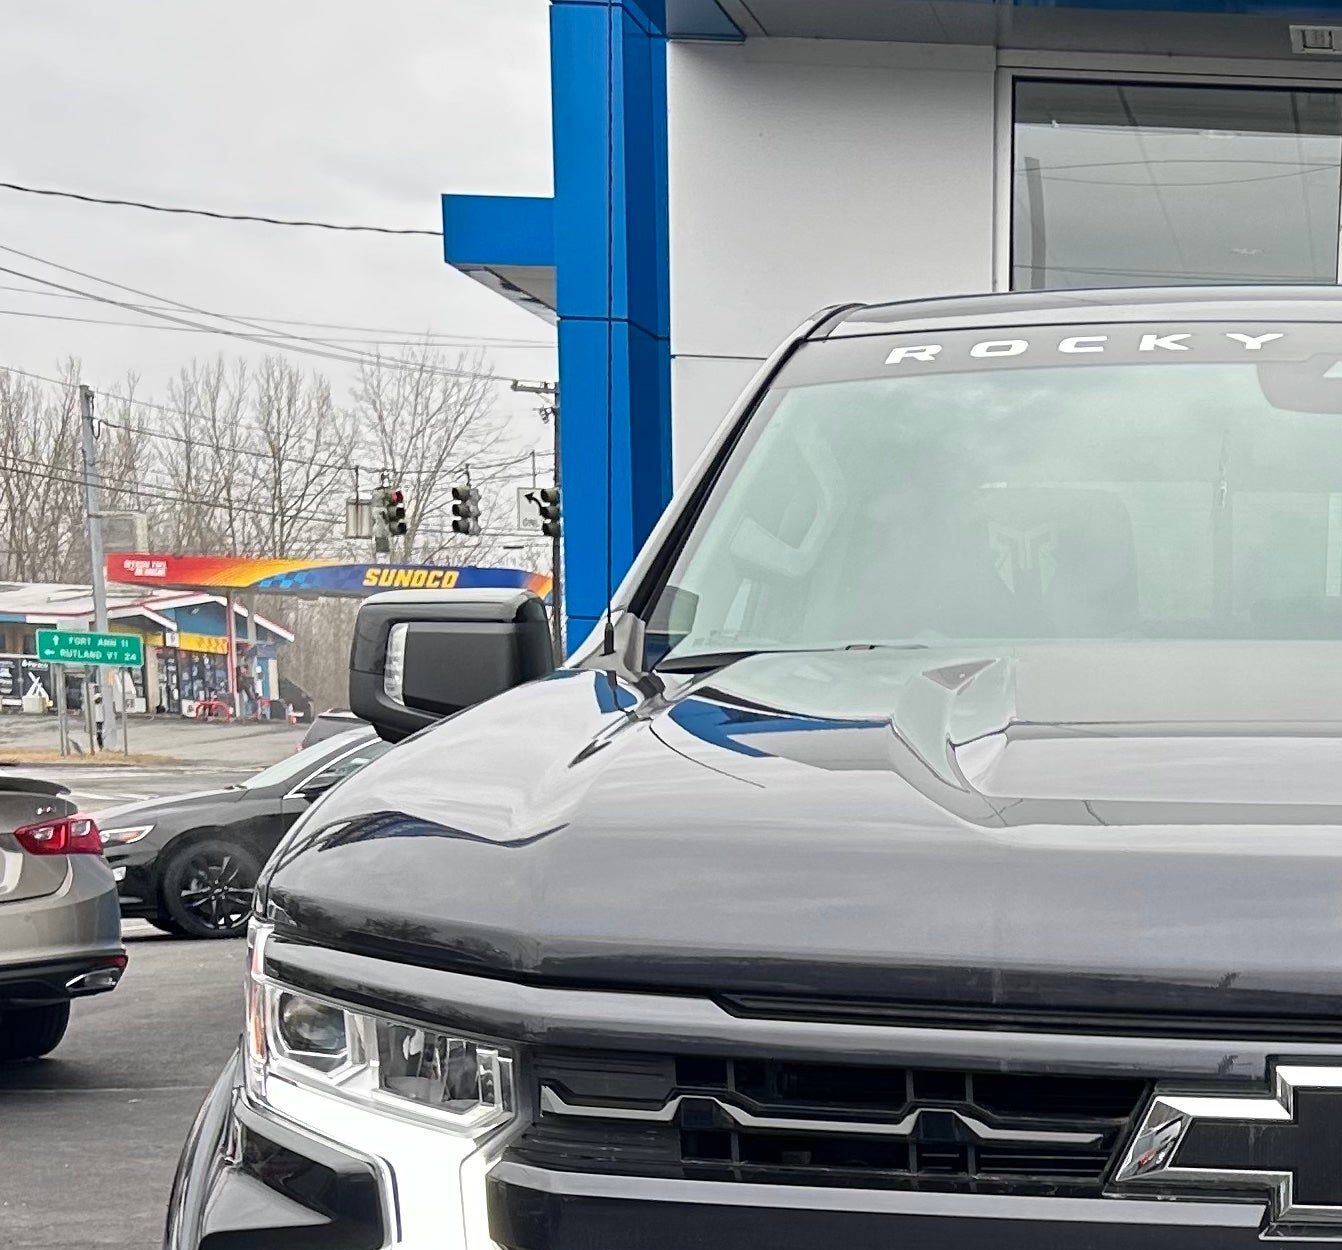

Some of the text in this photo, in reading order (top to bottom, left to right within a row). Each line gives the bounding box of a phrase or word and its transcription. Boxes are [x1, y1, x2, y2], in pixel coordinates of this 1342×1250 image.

[883, 332, 1285, 366] ROCKY
[362, 567, 460, 589] SUNOCO
[68, 636, 92, 646] FORT
[60, 648, 102, 660] RUTLAND
[124, 652, 137, 661] 24
